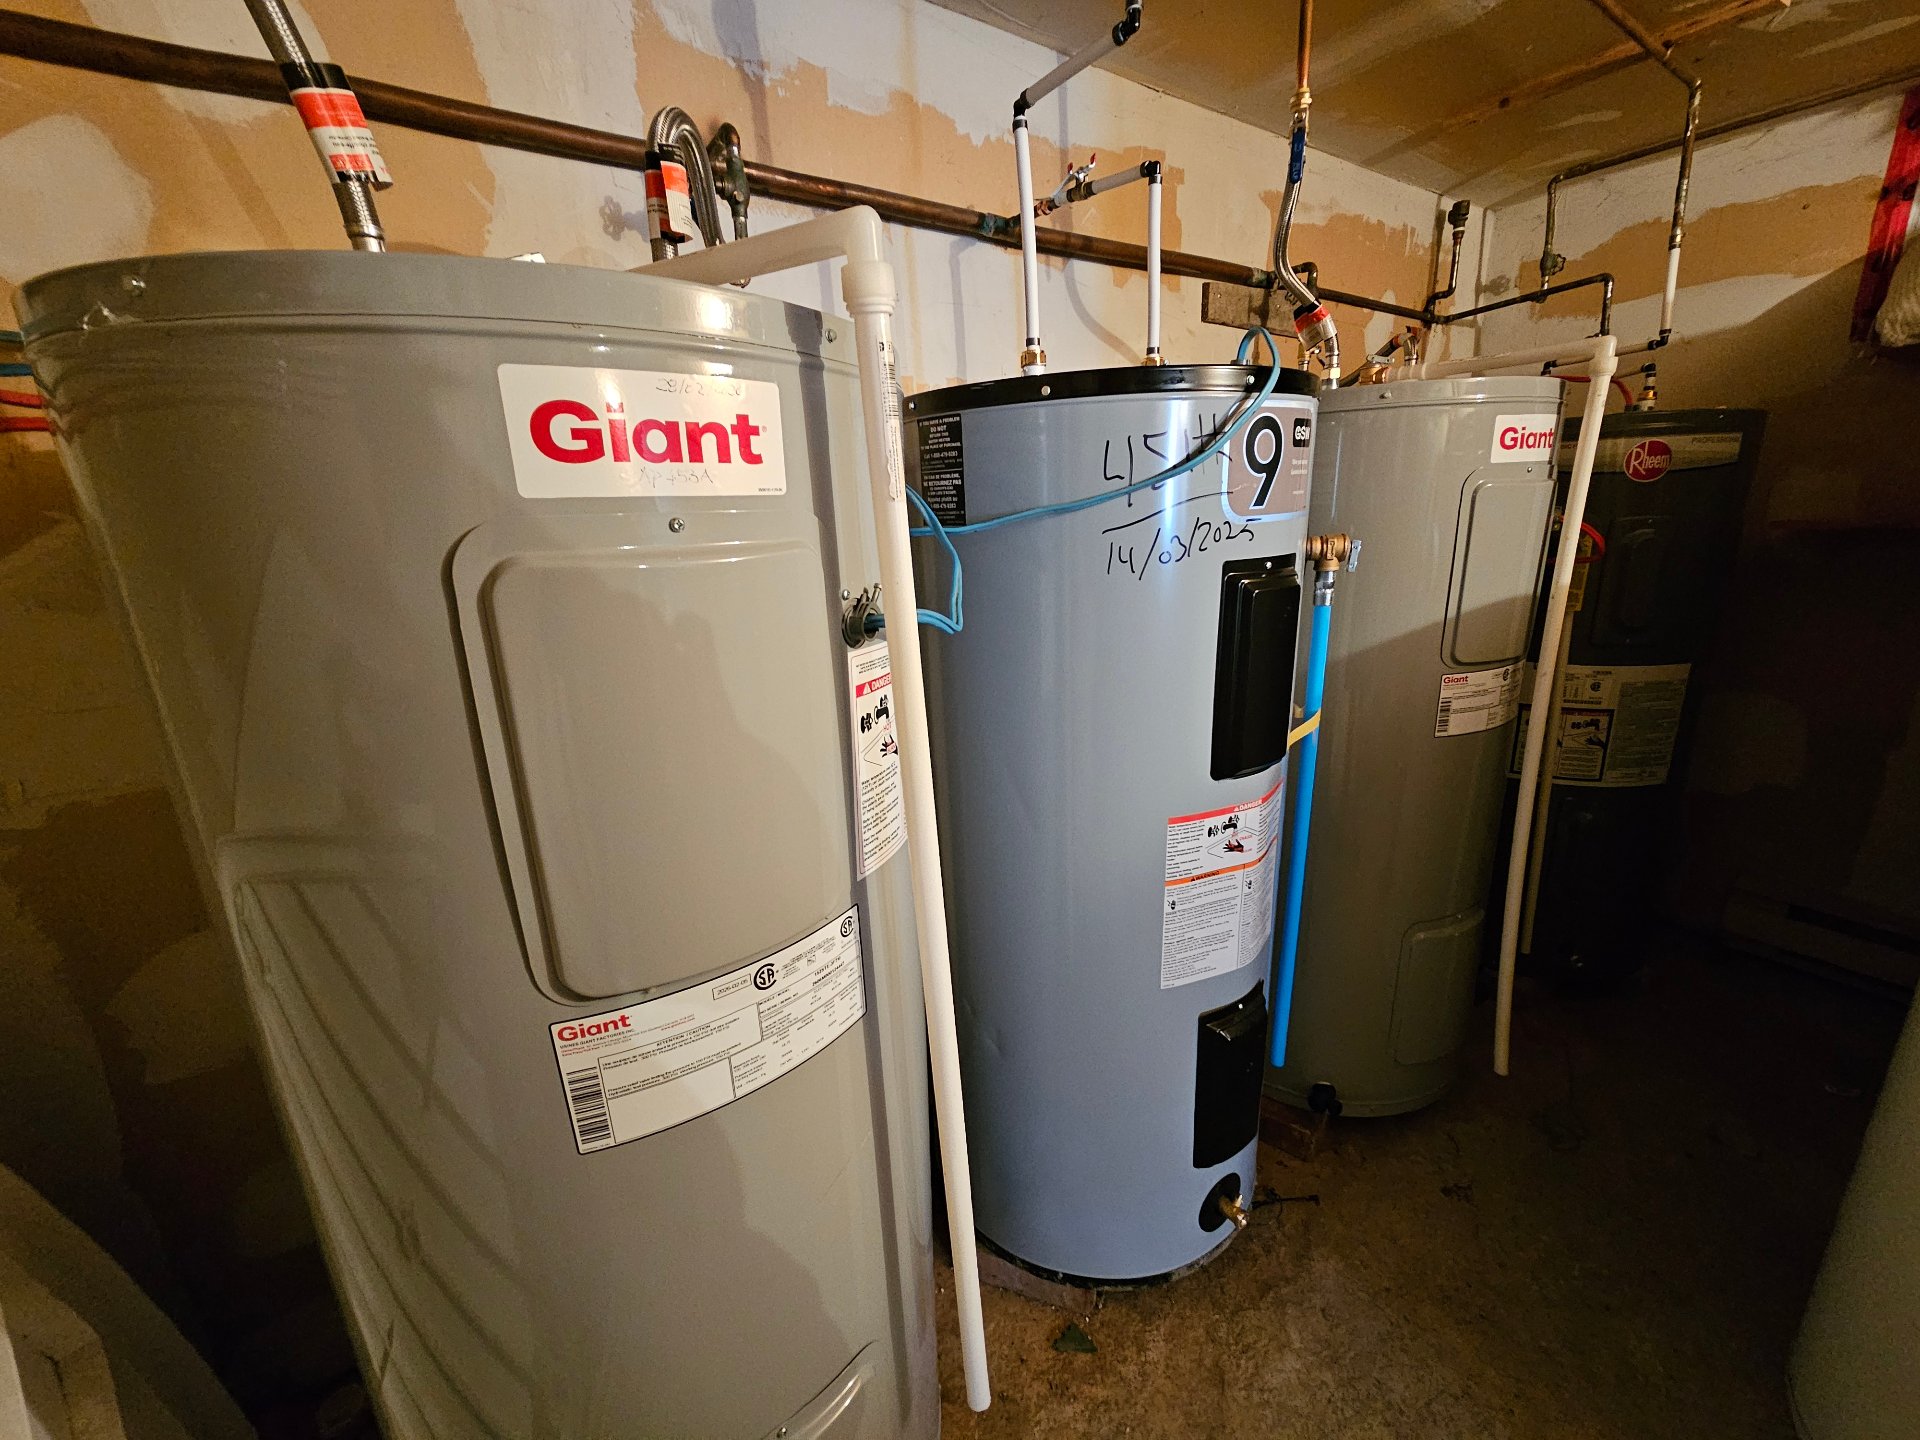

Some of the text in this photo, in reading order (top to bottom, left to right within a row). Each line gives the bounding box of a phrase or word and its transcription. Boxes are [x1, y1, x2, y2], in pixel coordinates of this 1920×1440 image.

[530, 399, 763, 464] Giant
[1499, 426, 1554, 451] Giant
[1243, 412, 1284, 510] 9
[1628, 441, 1671, 475] Rheem
[871, 674, 892, 692] DANGE
[1443, 675, 1469, 684] Giant
[1239, 799, 1262, 812] DANGER
[557, 1014, 631, 1042] Giant
